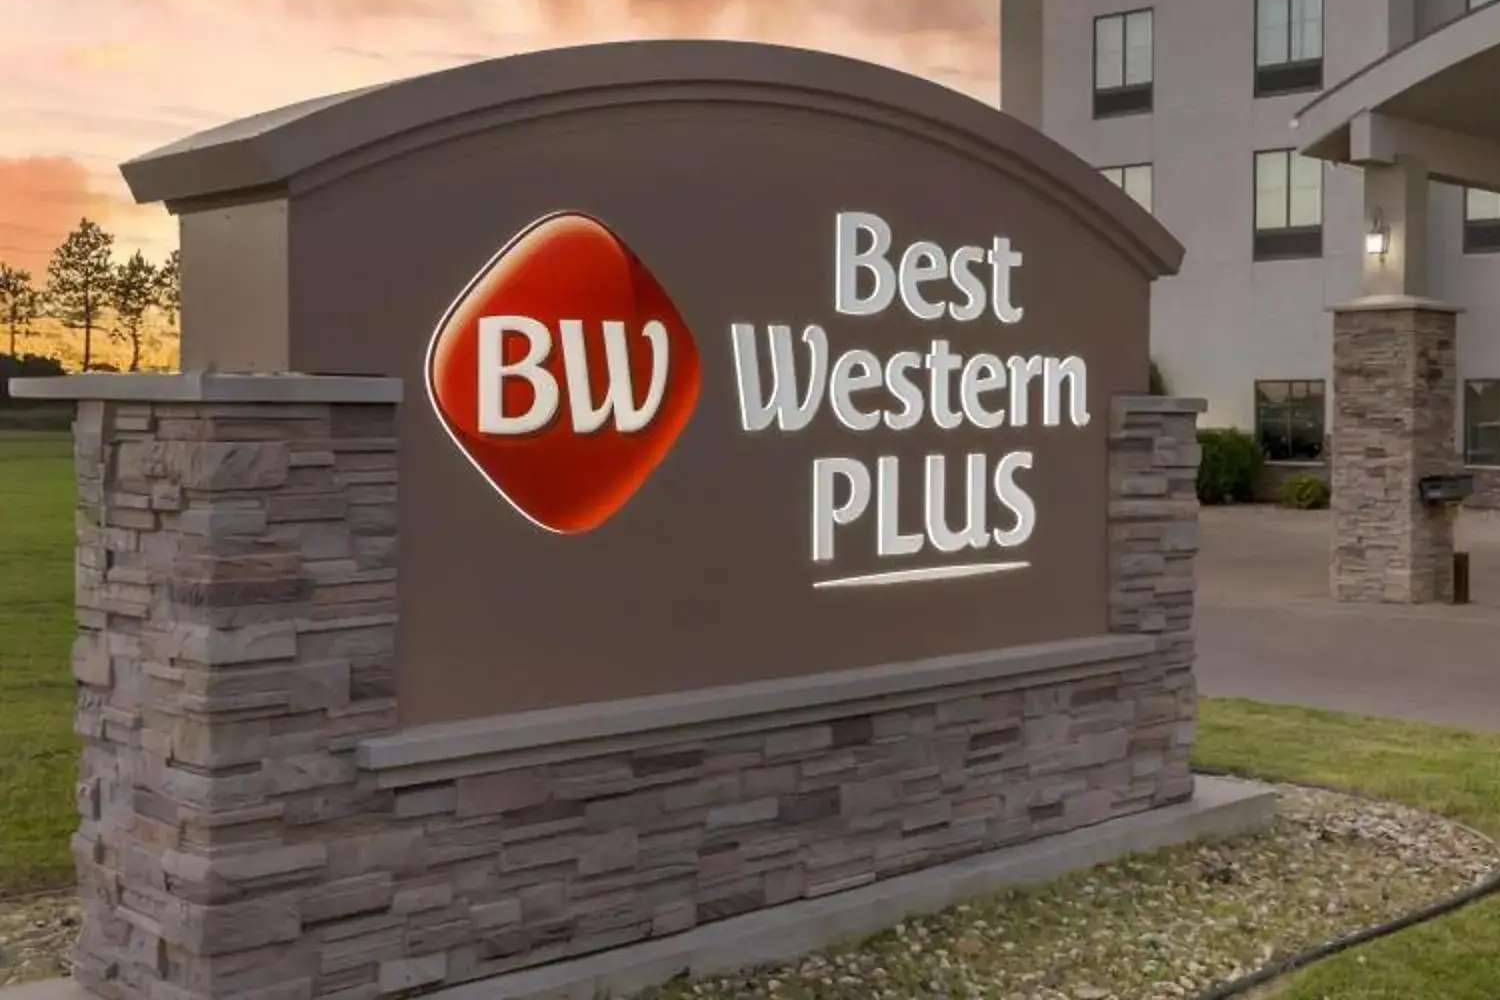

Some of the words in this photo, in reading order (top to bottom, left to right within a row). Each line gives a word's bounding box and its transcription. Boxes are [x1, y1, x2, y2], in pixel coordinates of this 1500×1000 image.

[835, 211, 1024, 324] Best
[477, 315, 672, 436] BW
[731, 322, 1091, 432] Western
[812, 451, 1037, 562] PLUS
